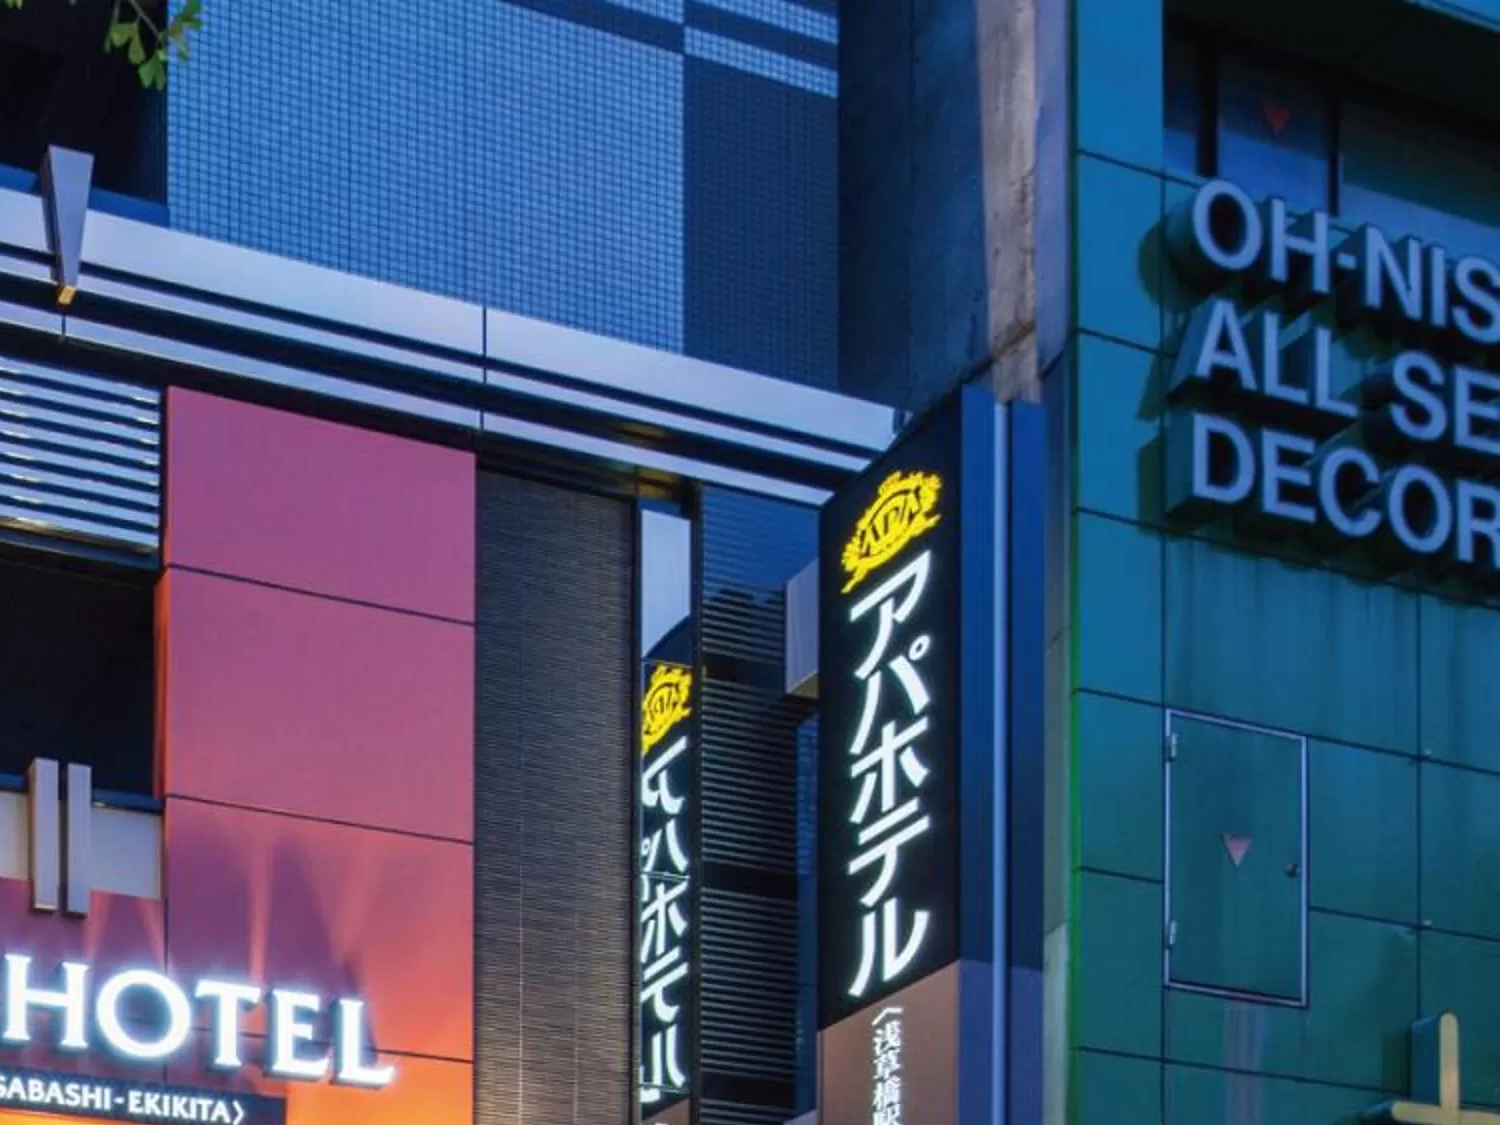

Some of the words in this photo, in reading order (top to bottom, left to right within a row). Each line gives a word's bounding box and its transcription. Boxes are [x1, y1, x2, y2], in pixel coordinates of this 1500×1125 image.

[1192, 178, 1500, 344] OH-NIS
[1194, 297, 1358, 418] ALL
[1389, 350, 1500, 457] SE
[1191, 412, 1500, 571] DECOR
[849, 550, 931, 997] アパホテル
[4, 953, 395, 1085] HOTEL
